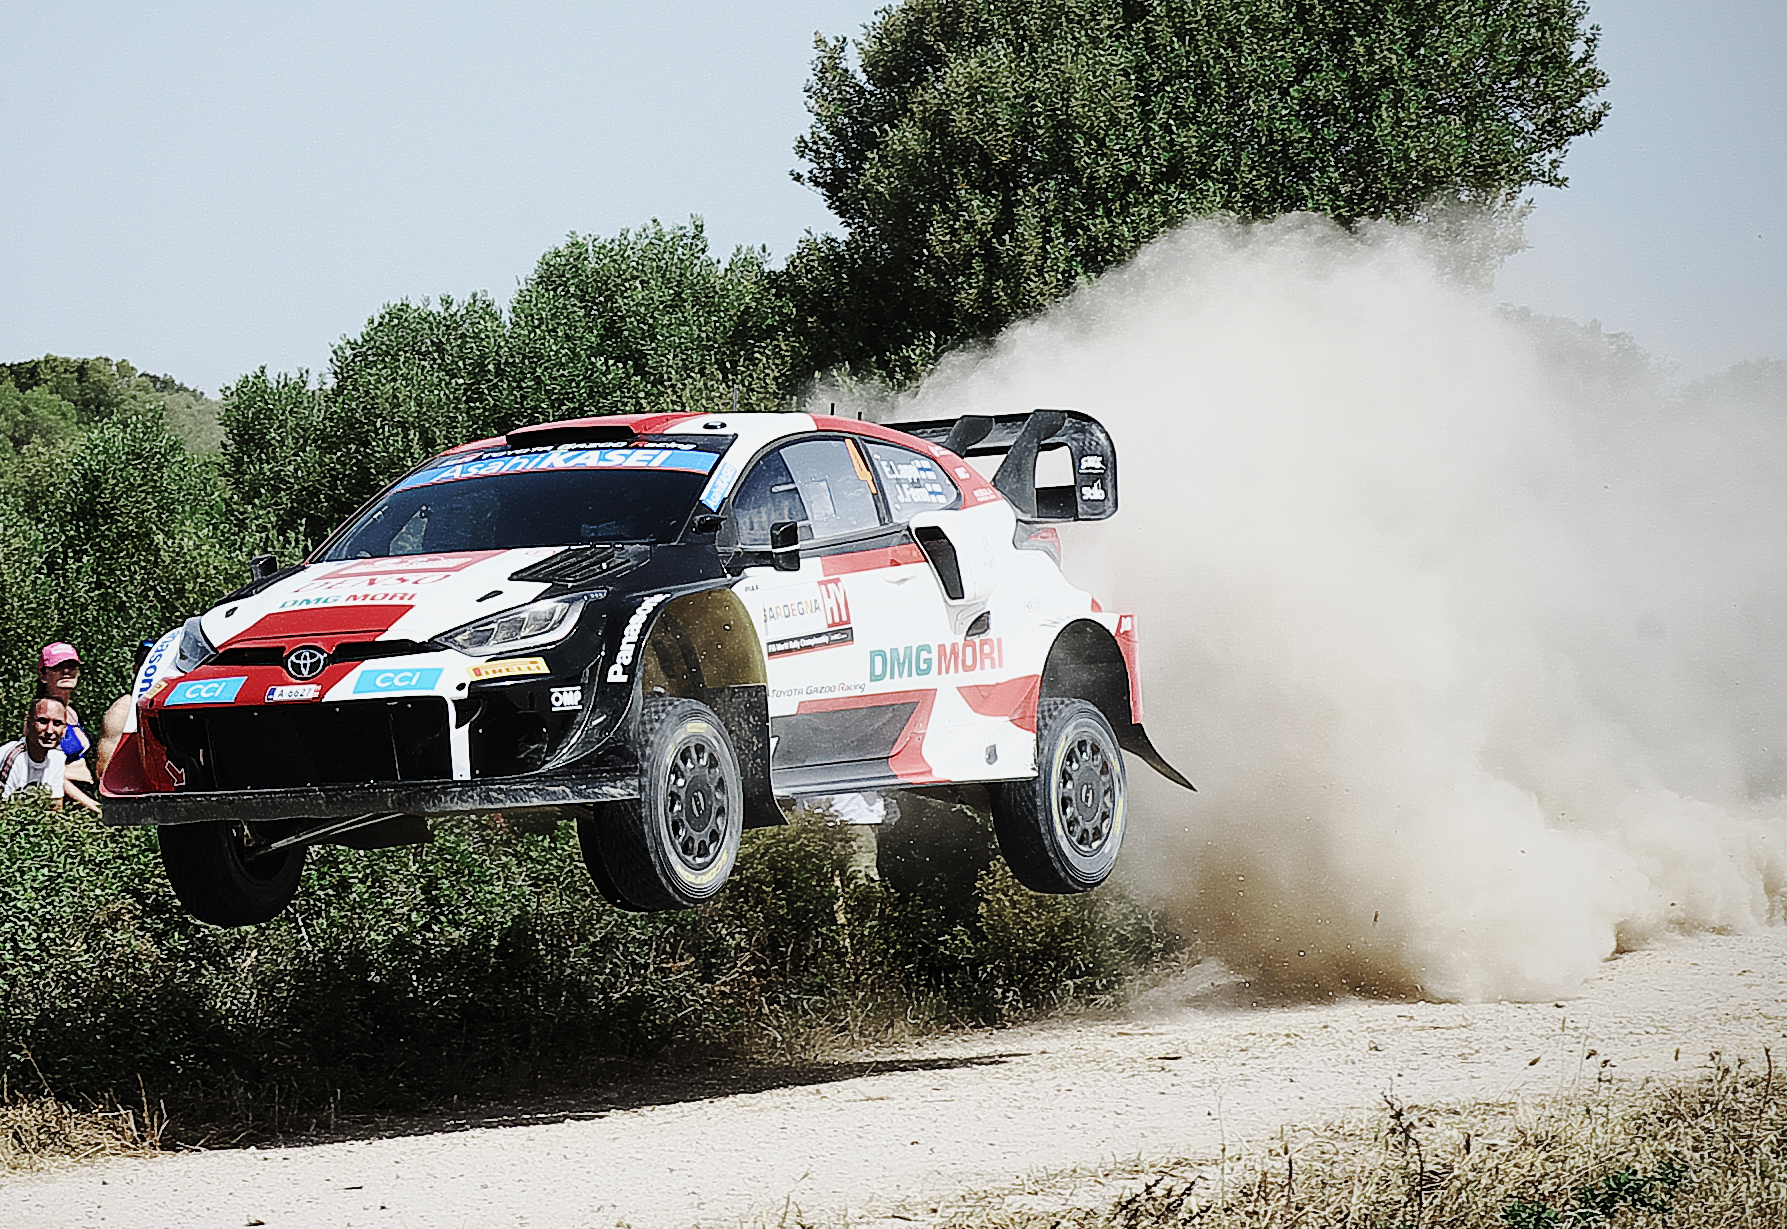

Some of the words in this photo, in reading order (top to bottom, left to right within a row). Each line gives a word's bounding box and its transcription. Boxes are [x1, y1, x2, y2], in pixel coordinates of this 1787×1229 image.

[431, 449, 672, 482] AsahiKASEI
[844, 438, 877, 494] 4
[279, 595, 341, 609] DMG
[346, 592, 418, 602] MORI
[869, 644, 933, 683] DMG
[937, 637, 1004, 676] MORI
[375, 671, 421, 688] CCI
